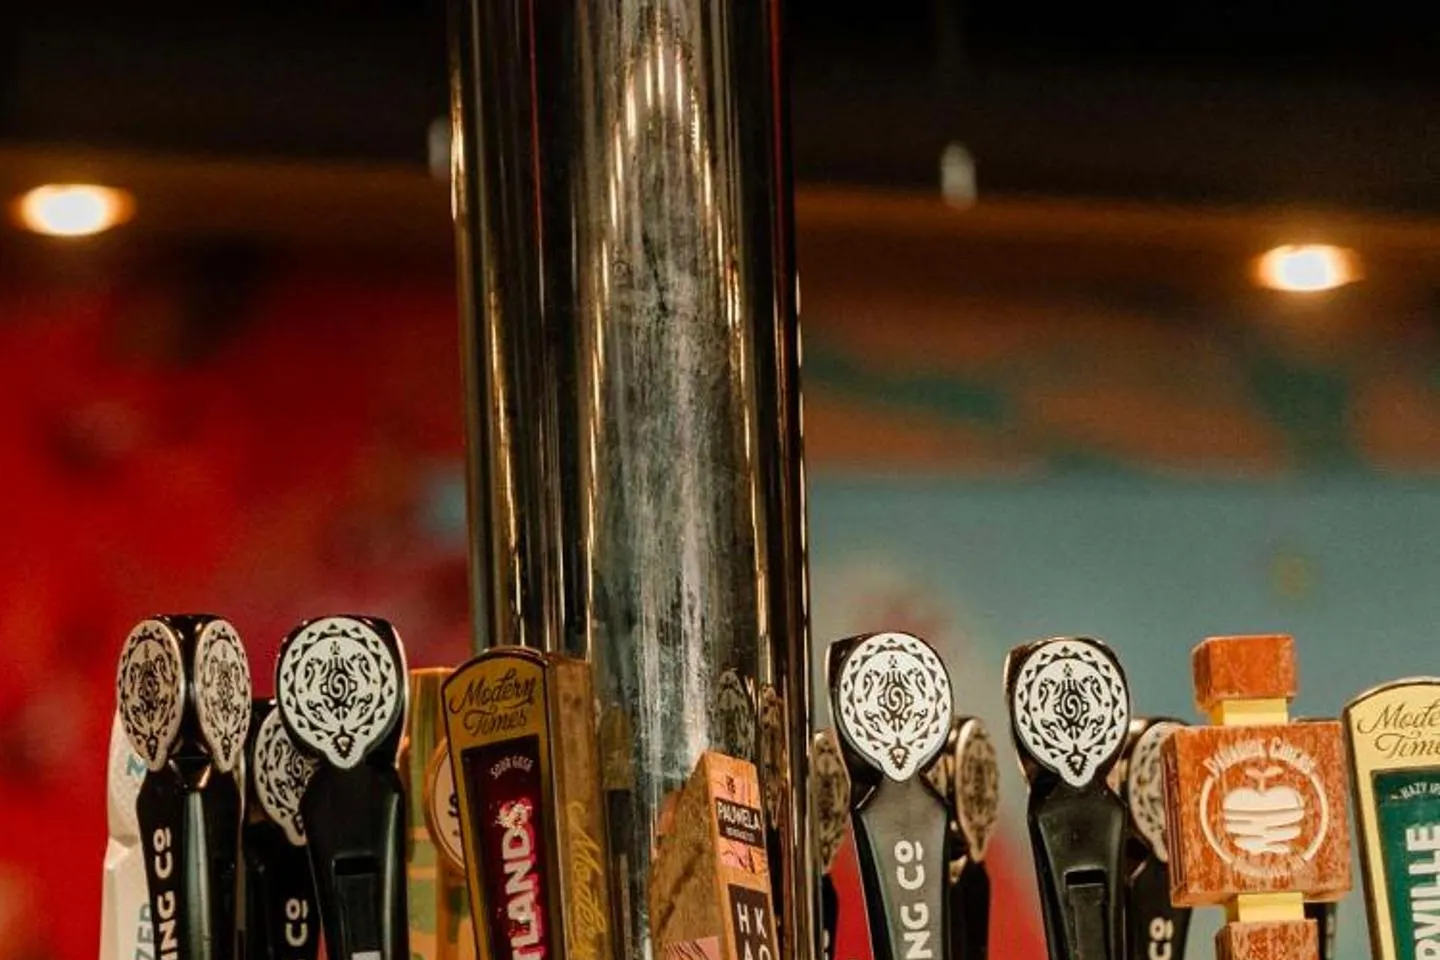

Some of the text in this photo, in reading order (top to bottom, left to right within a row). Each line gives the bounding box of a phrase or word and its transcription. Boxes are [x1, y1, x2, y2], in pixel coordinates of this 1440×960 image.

[449, 667, 536, 713] Modern
[464, 705, 527, 737] Times
[1357, 700, 1440, 734] Mode
